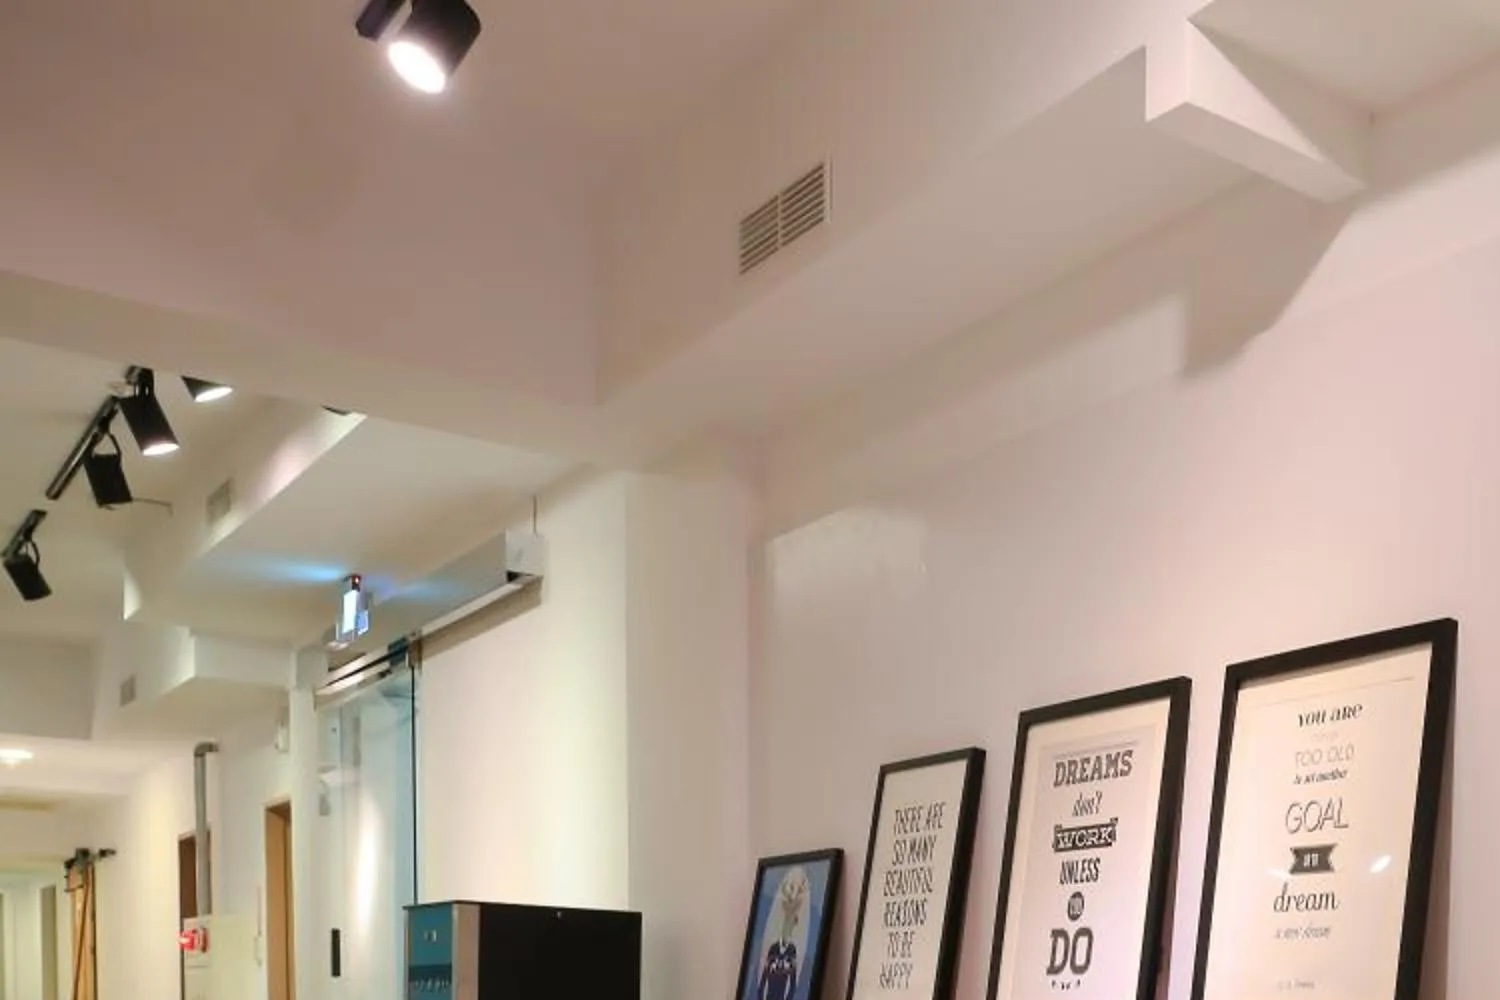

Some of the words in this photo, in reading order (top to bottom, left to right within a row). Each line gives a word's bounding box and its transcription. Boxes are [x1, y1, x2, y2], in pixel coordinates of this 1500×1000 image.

[1053, 749, 1134, 789] DREAMS
[1285, 796, 1350, 835] GOAL
[1056, 825, 1115, 850] WORK
[1059, 857, 1101, 886] UNLESS
[1273, 881, 1341, 913] dream
[1046, 926, 1095, 977] DO
